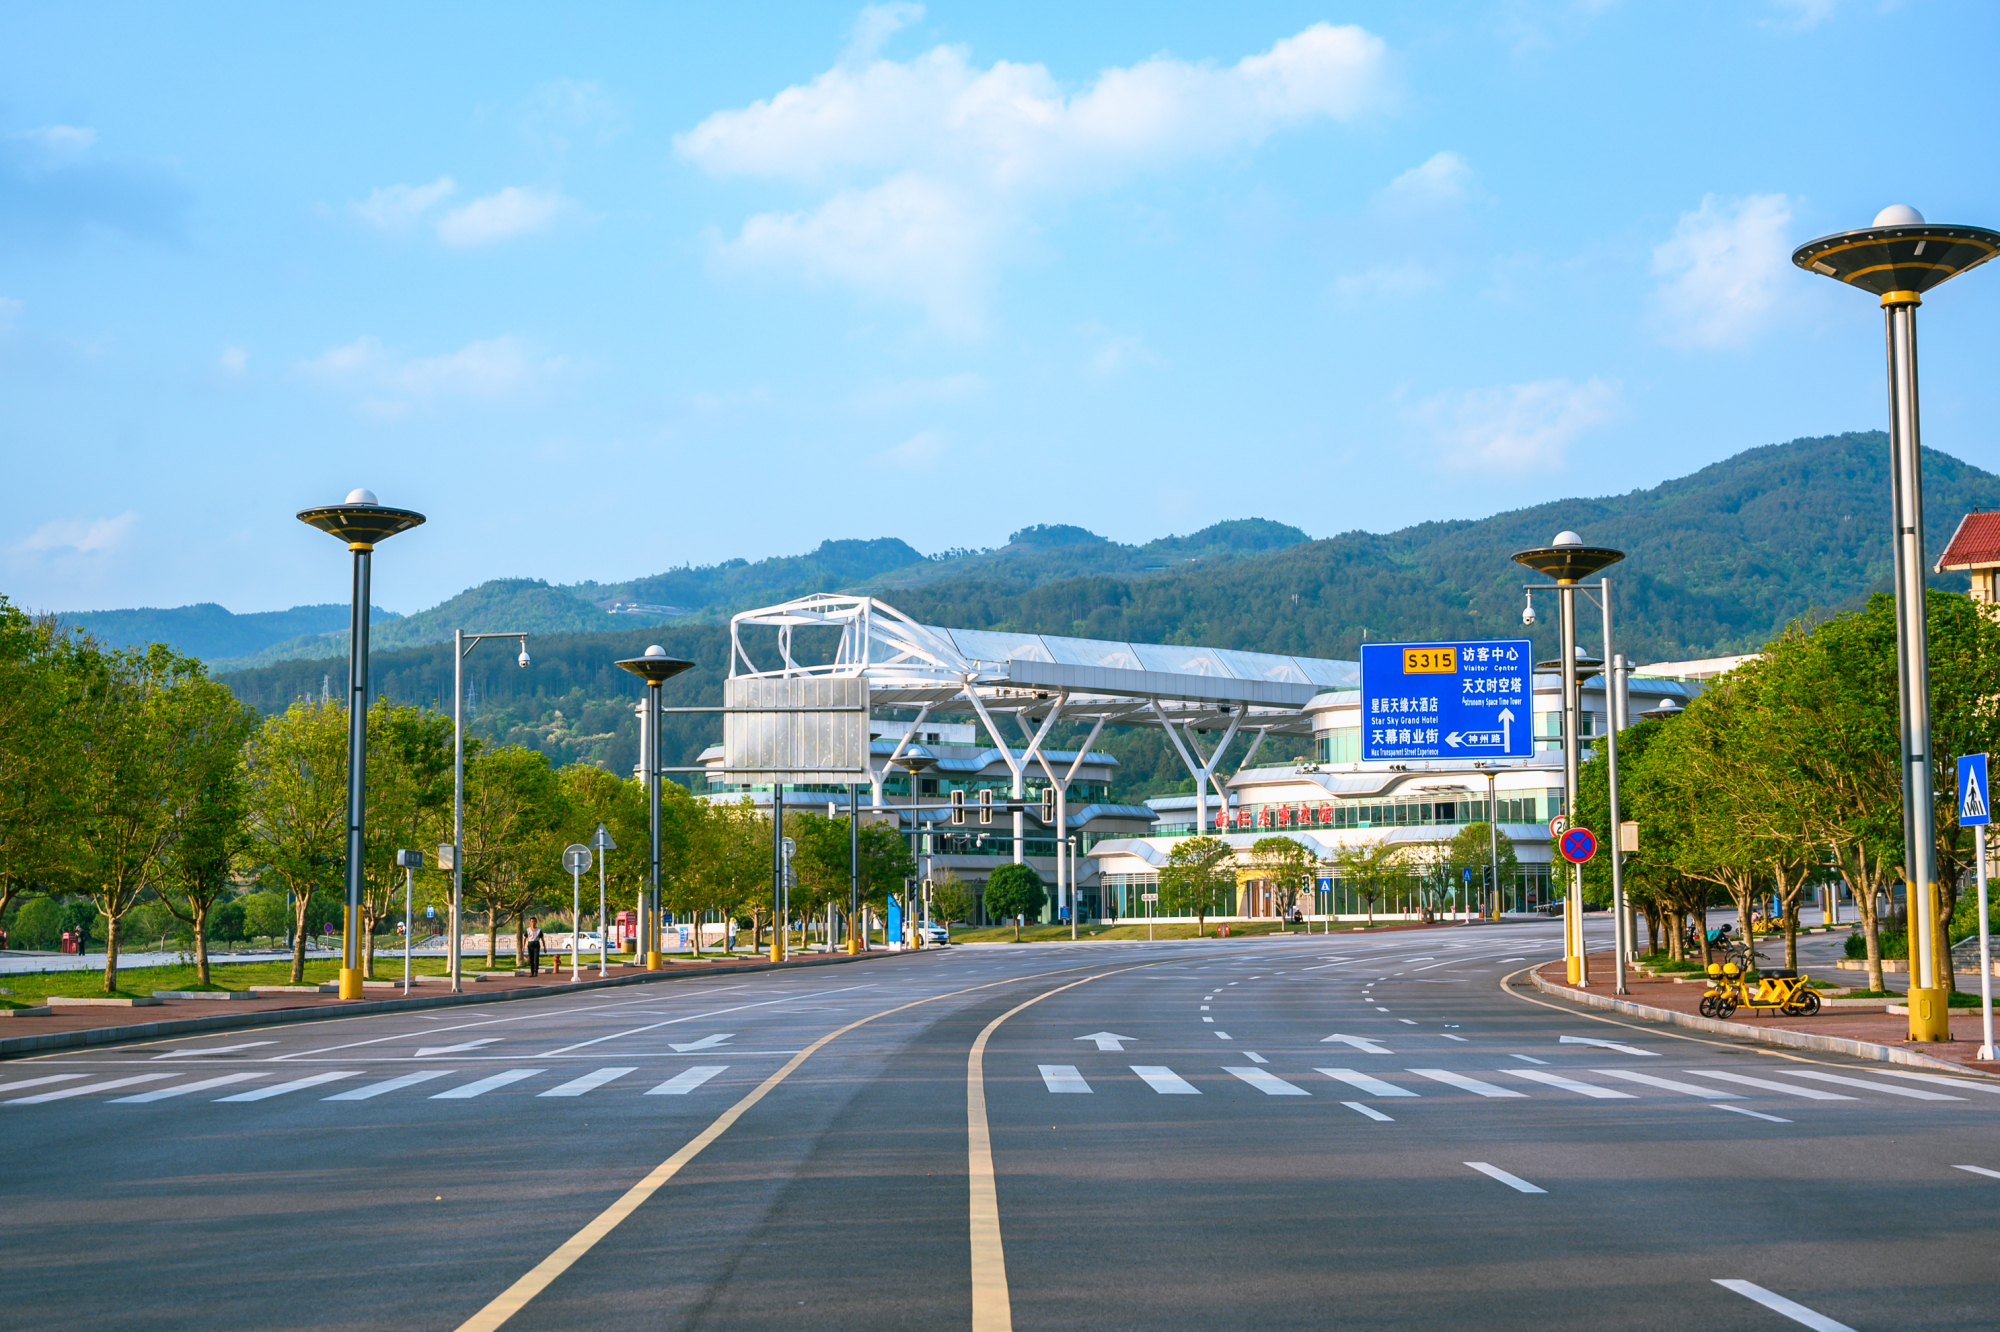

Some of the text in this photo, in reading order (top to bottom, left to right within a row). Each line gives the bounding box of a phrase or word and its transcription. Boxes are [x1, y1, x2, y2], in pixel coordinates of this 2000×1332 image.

[1408, 654, 1452, 668] S315
[1462, 647, 1519, 662] 访客中心
[1463, 664, 1518, 672] Visitor Center
[1462, 677, 1522, 694] 天文时空塔
[1371, 696, 1438, 713] 星辰天缘大酒店
[1486, 697, 1498, 707] Space
[1499, 697, 1509, 705] Time
[1510, 697, 1522, 705] Tower
[1371, 715, 1438, 726] Star Sky Grand Hotel
[1371, 728, 1439, 745] 天幕商业街
[1468, 734, 1501, 744] 神州路
[1404, 748, 1417, 756] Street
[1417, 747, 1439, 757] Experience
[1214, 802, 1334, 828] 南仁东事迹馆
